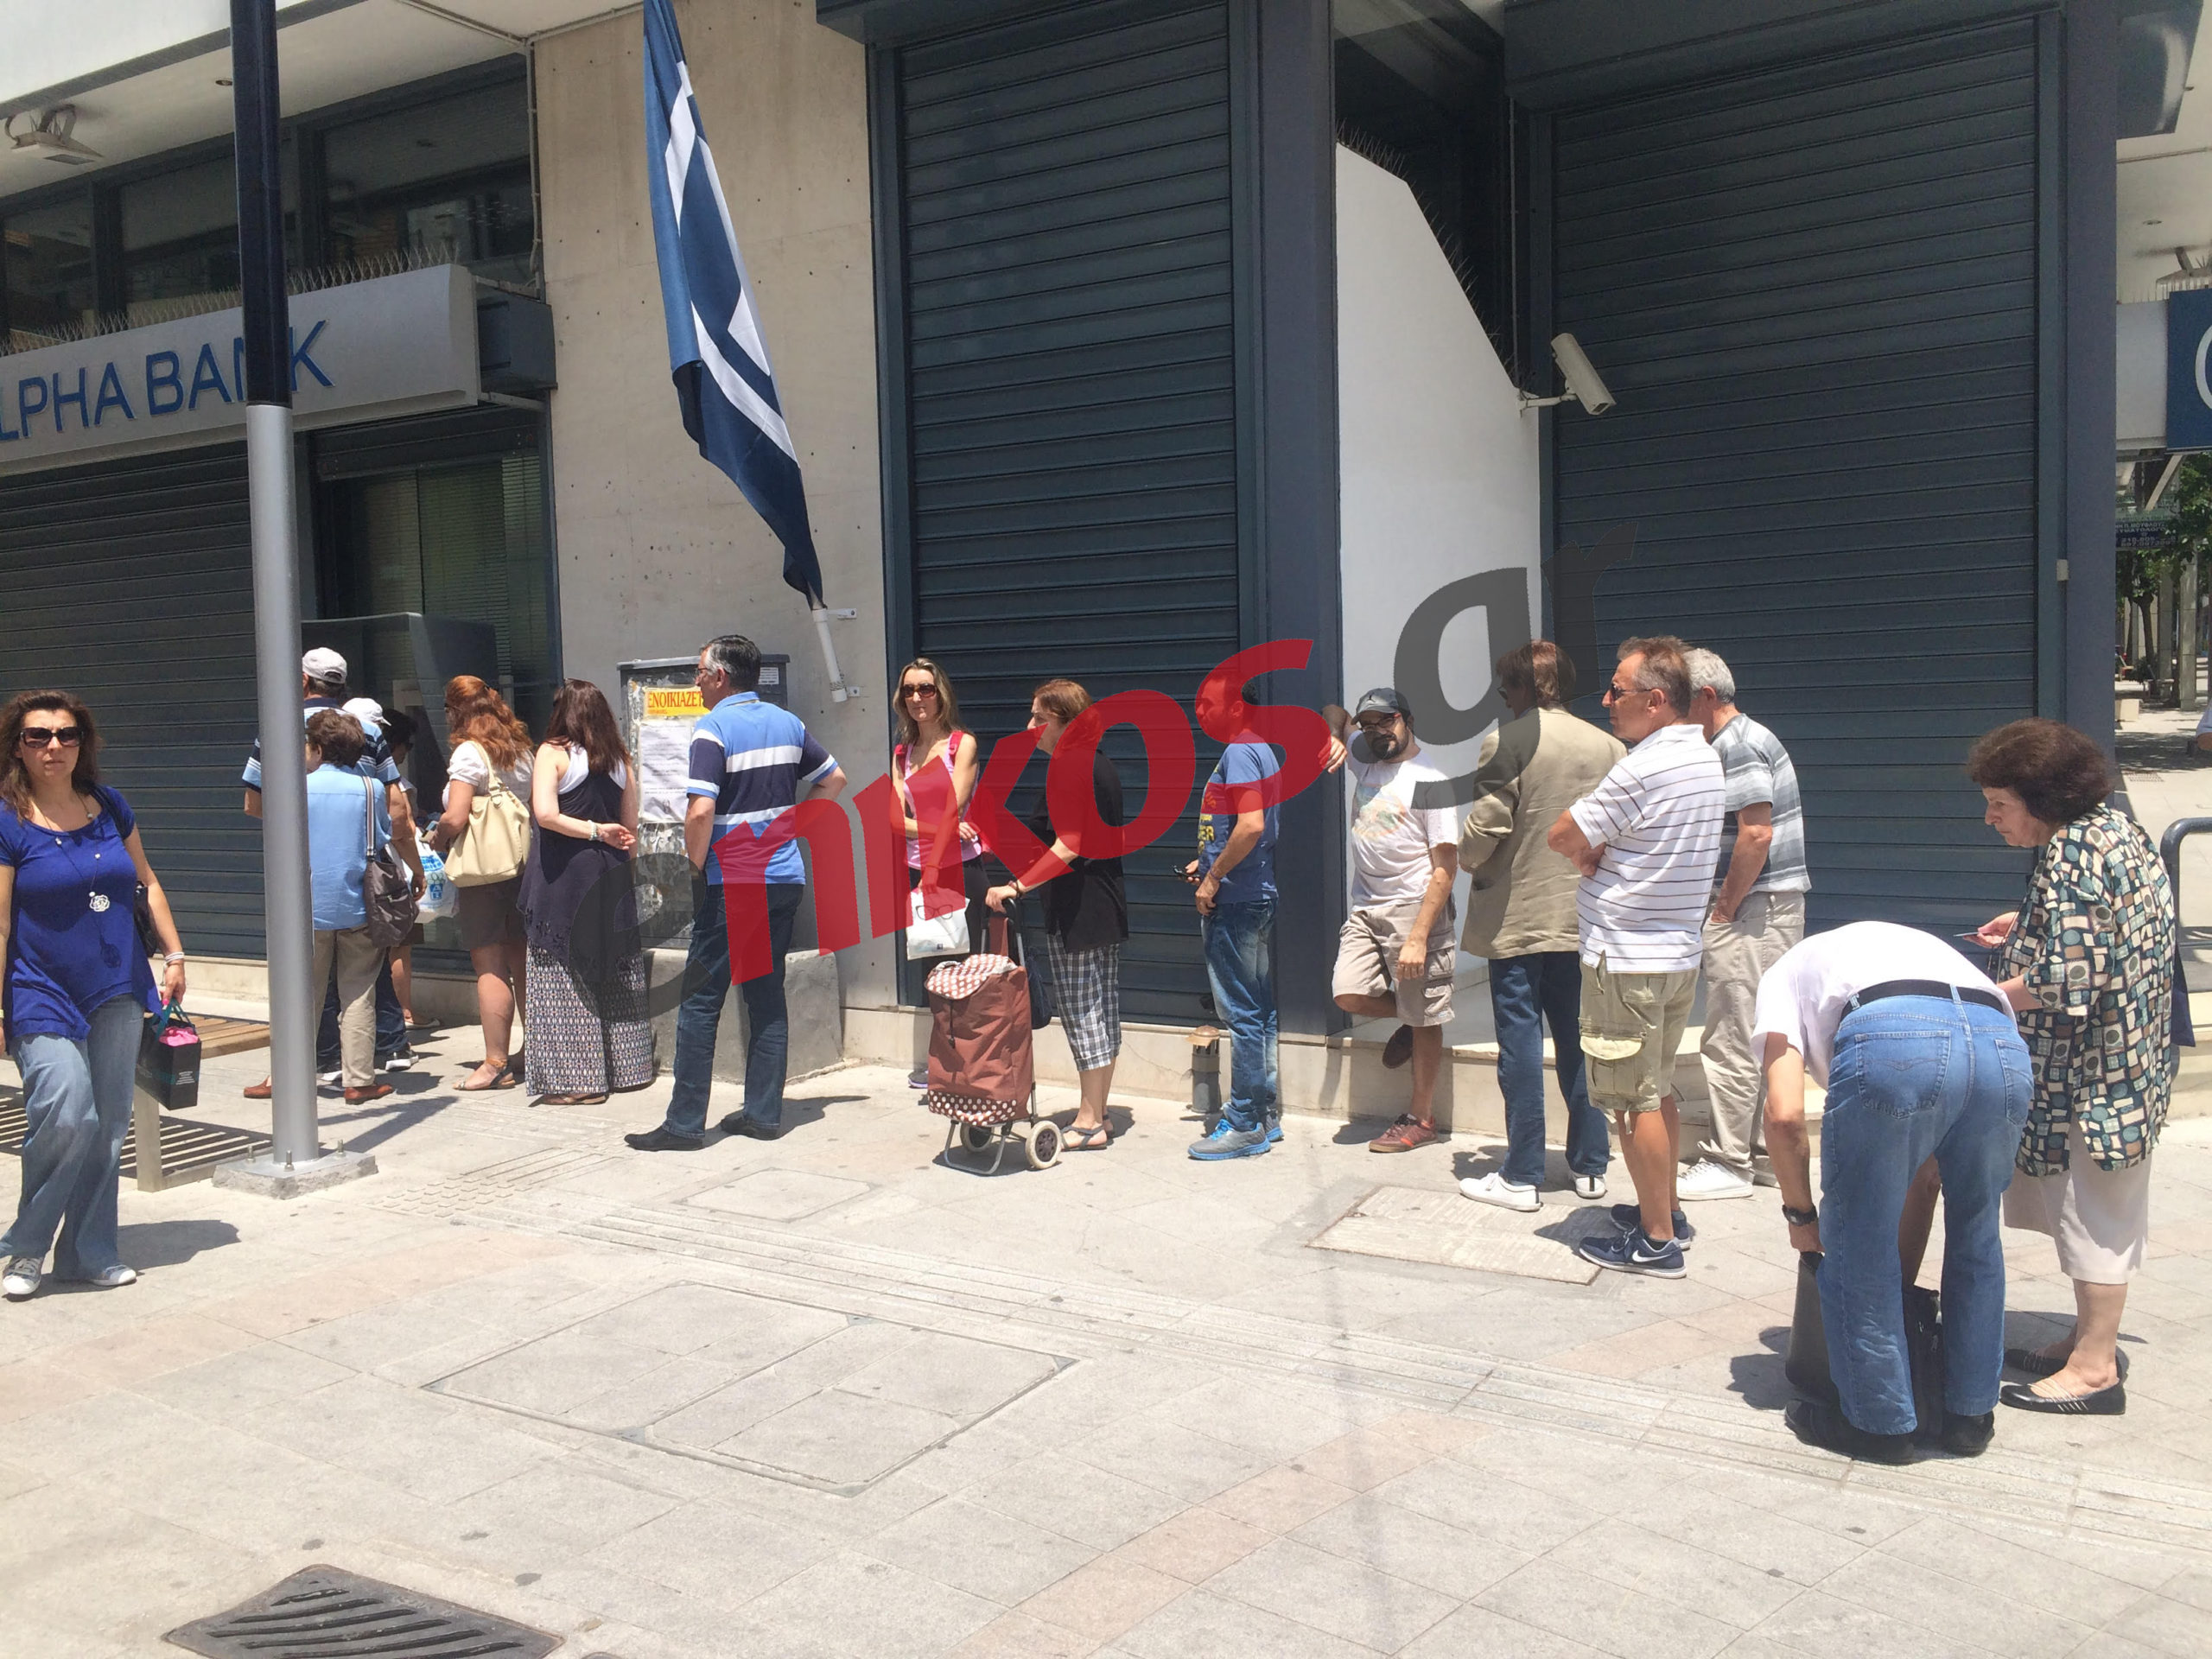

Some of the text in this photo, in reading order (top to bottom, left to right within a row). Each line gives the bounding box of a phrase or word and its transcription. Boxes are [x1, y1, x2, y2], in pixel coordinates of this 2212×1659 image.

[0, 319, 335, 442] LPHA BAK
[647, 690, 704, 709] ΕΝΟΙΚΙΑΖΕΤ
